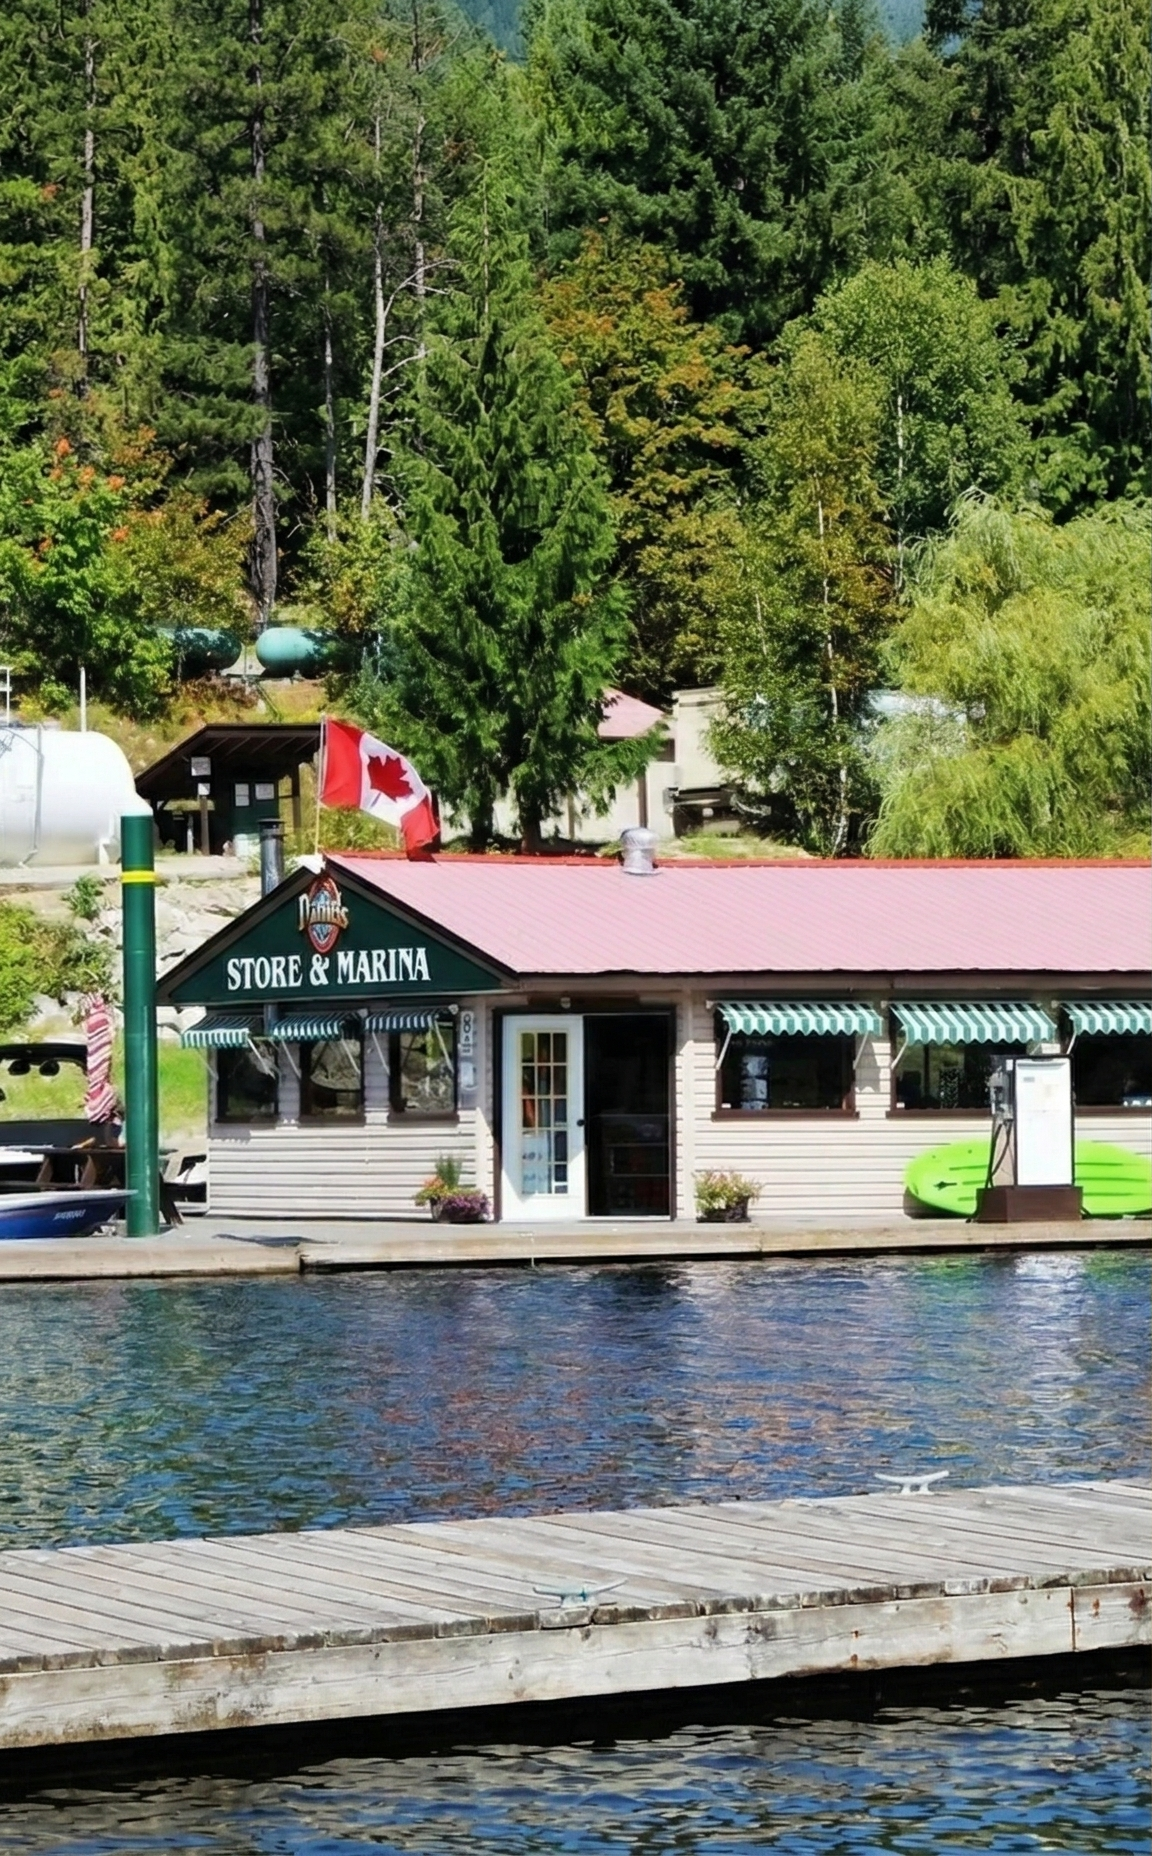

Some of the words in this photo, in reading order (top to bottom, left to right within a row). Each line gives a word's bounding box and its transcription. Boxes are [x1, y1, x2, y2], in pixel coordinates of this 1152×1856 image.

[227, 955, 303, 991] STORE
[309, 953, 330, 986] &
[336, 947, 431, 985] MARINA
